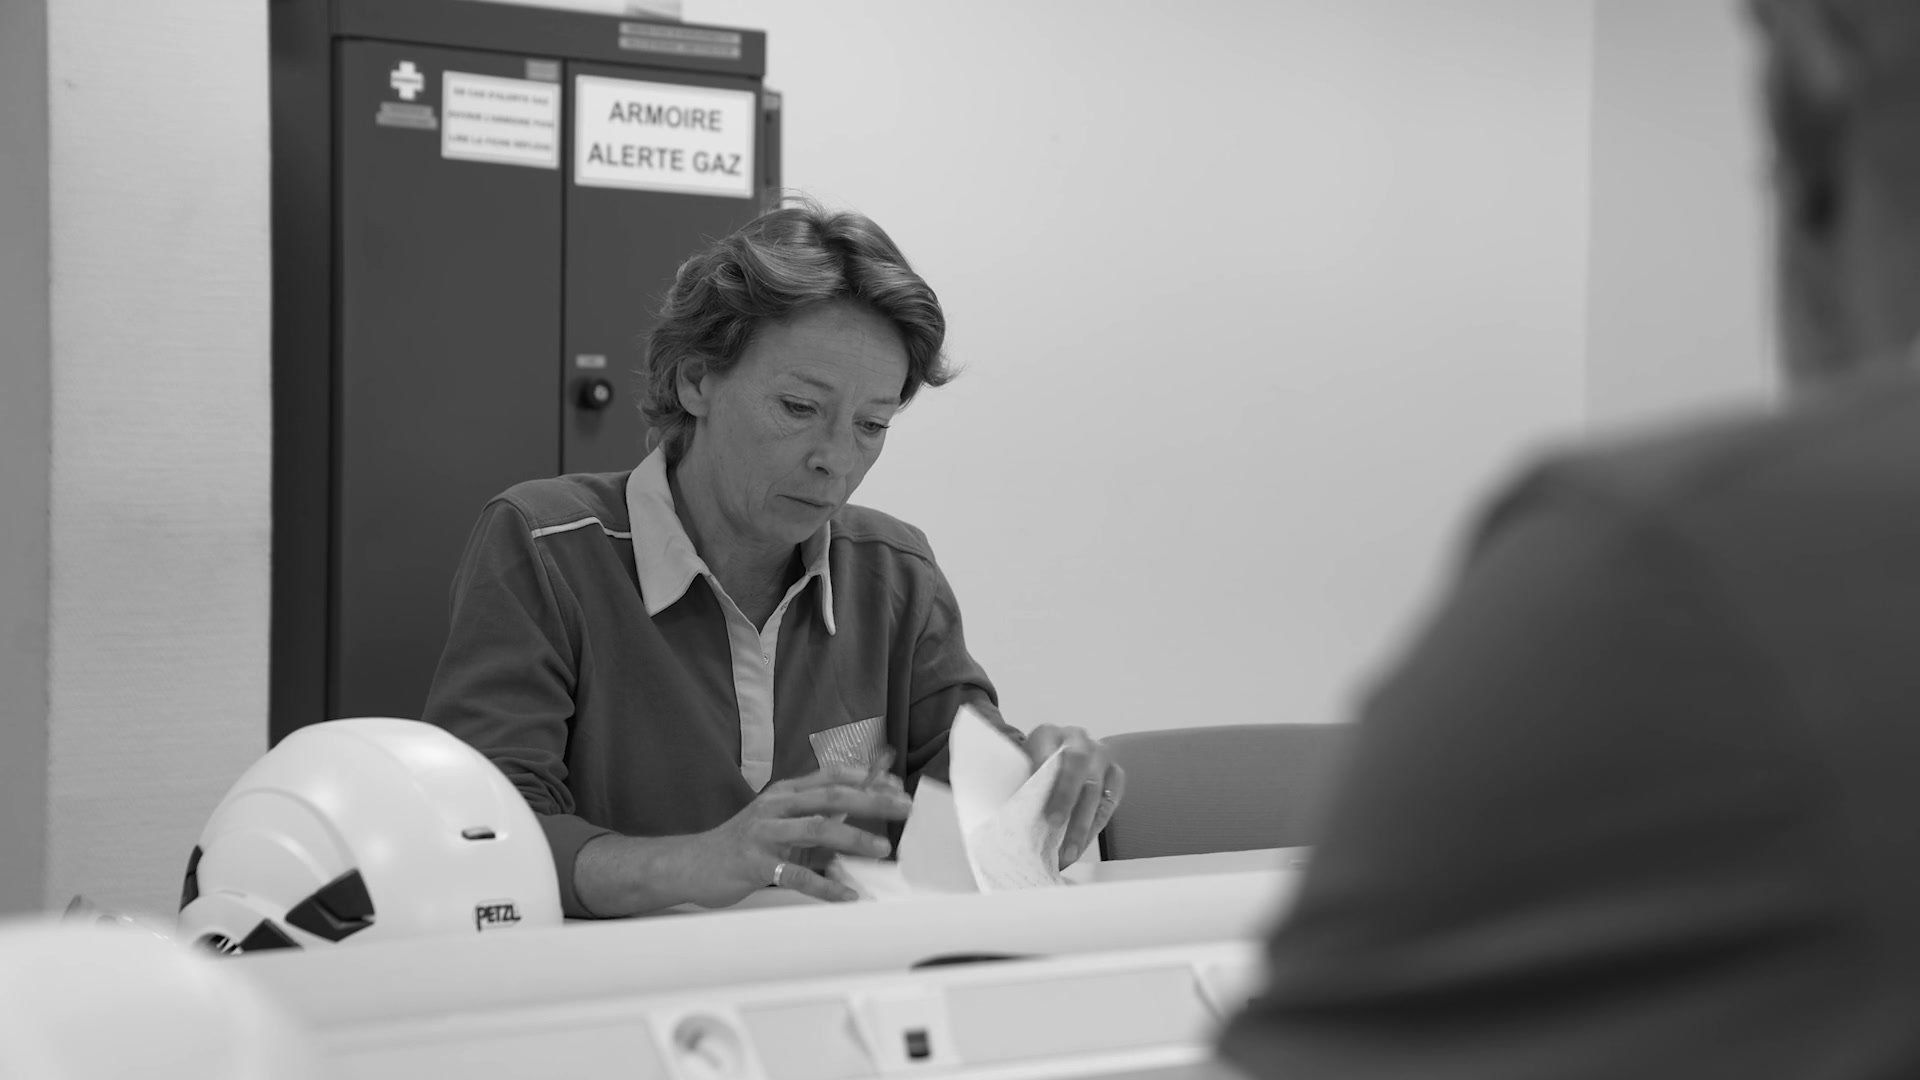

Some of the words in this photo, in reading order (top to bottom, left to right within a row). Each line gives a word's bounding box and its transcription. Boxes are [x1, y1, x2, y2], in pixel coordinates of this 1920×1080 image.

[609, 100, 722, 132] ARMOIRE
[587, 142, 684, 171] ALERTE
[692, 150, 743, 176] GAZ
[476, 904, 521, 932] PETZL
